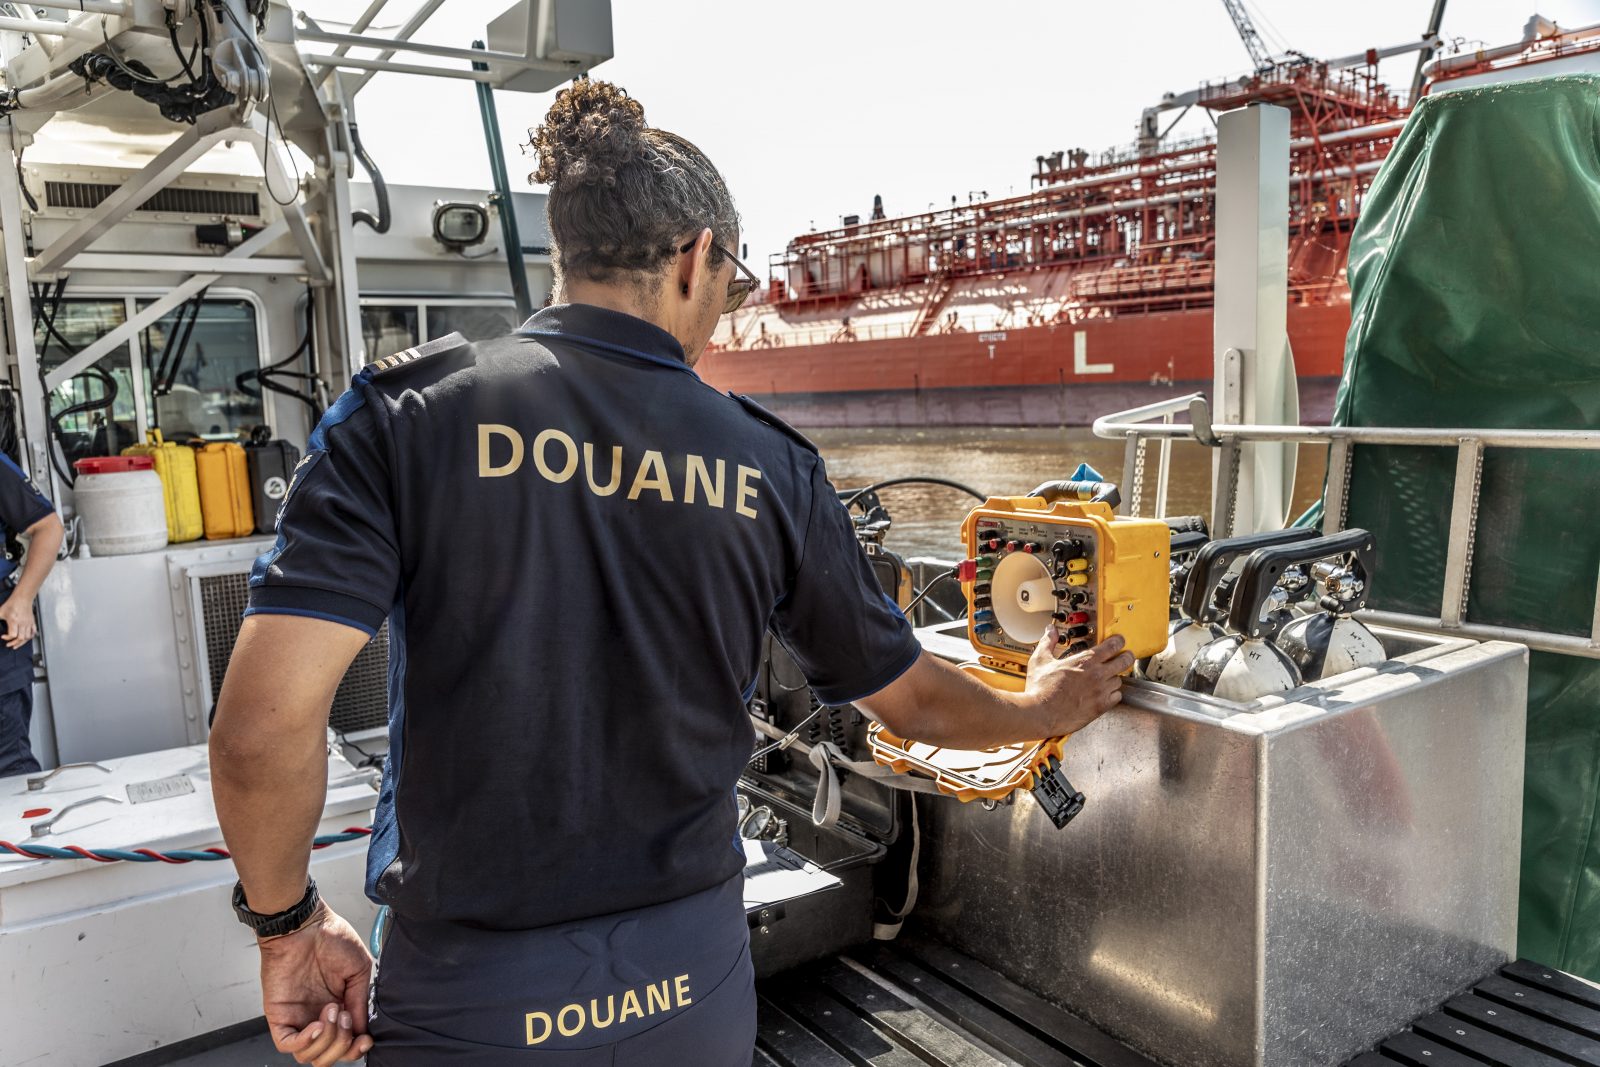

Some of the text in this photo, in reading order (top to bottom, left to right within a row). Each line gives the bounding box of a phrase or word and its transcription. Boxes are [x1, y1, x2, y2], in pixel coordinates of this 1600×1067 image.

[1074, 331, 1114, 374] L
[478, 424, 762, 519] DOUANE
[525, 973, 692, 1046] DOUANE
